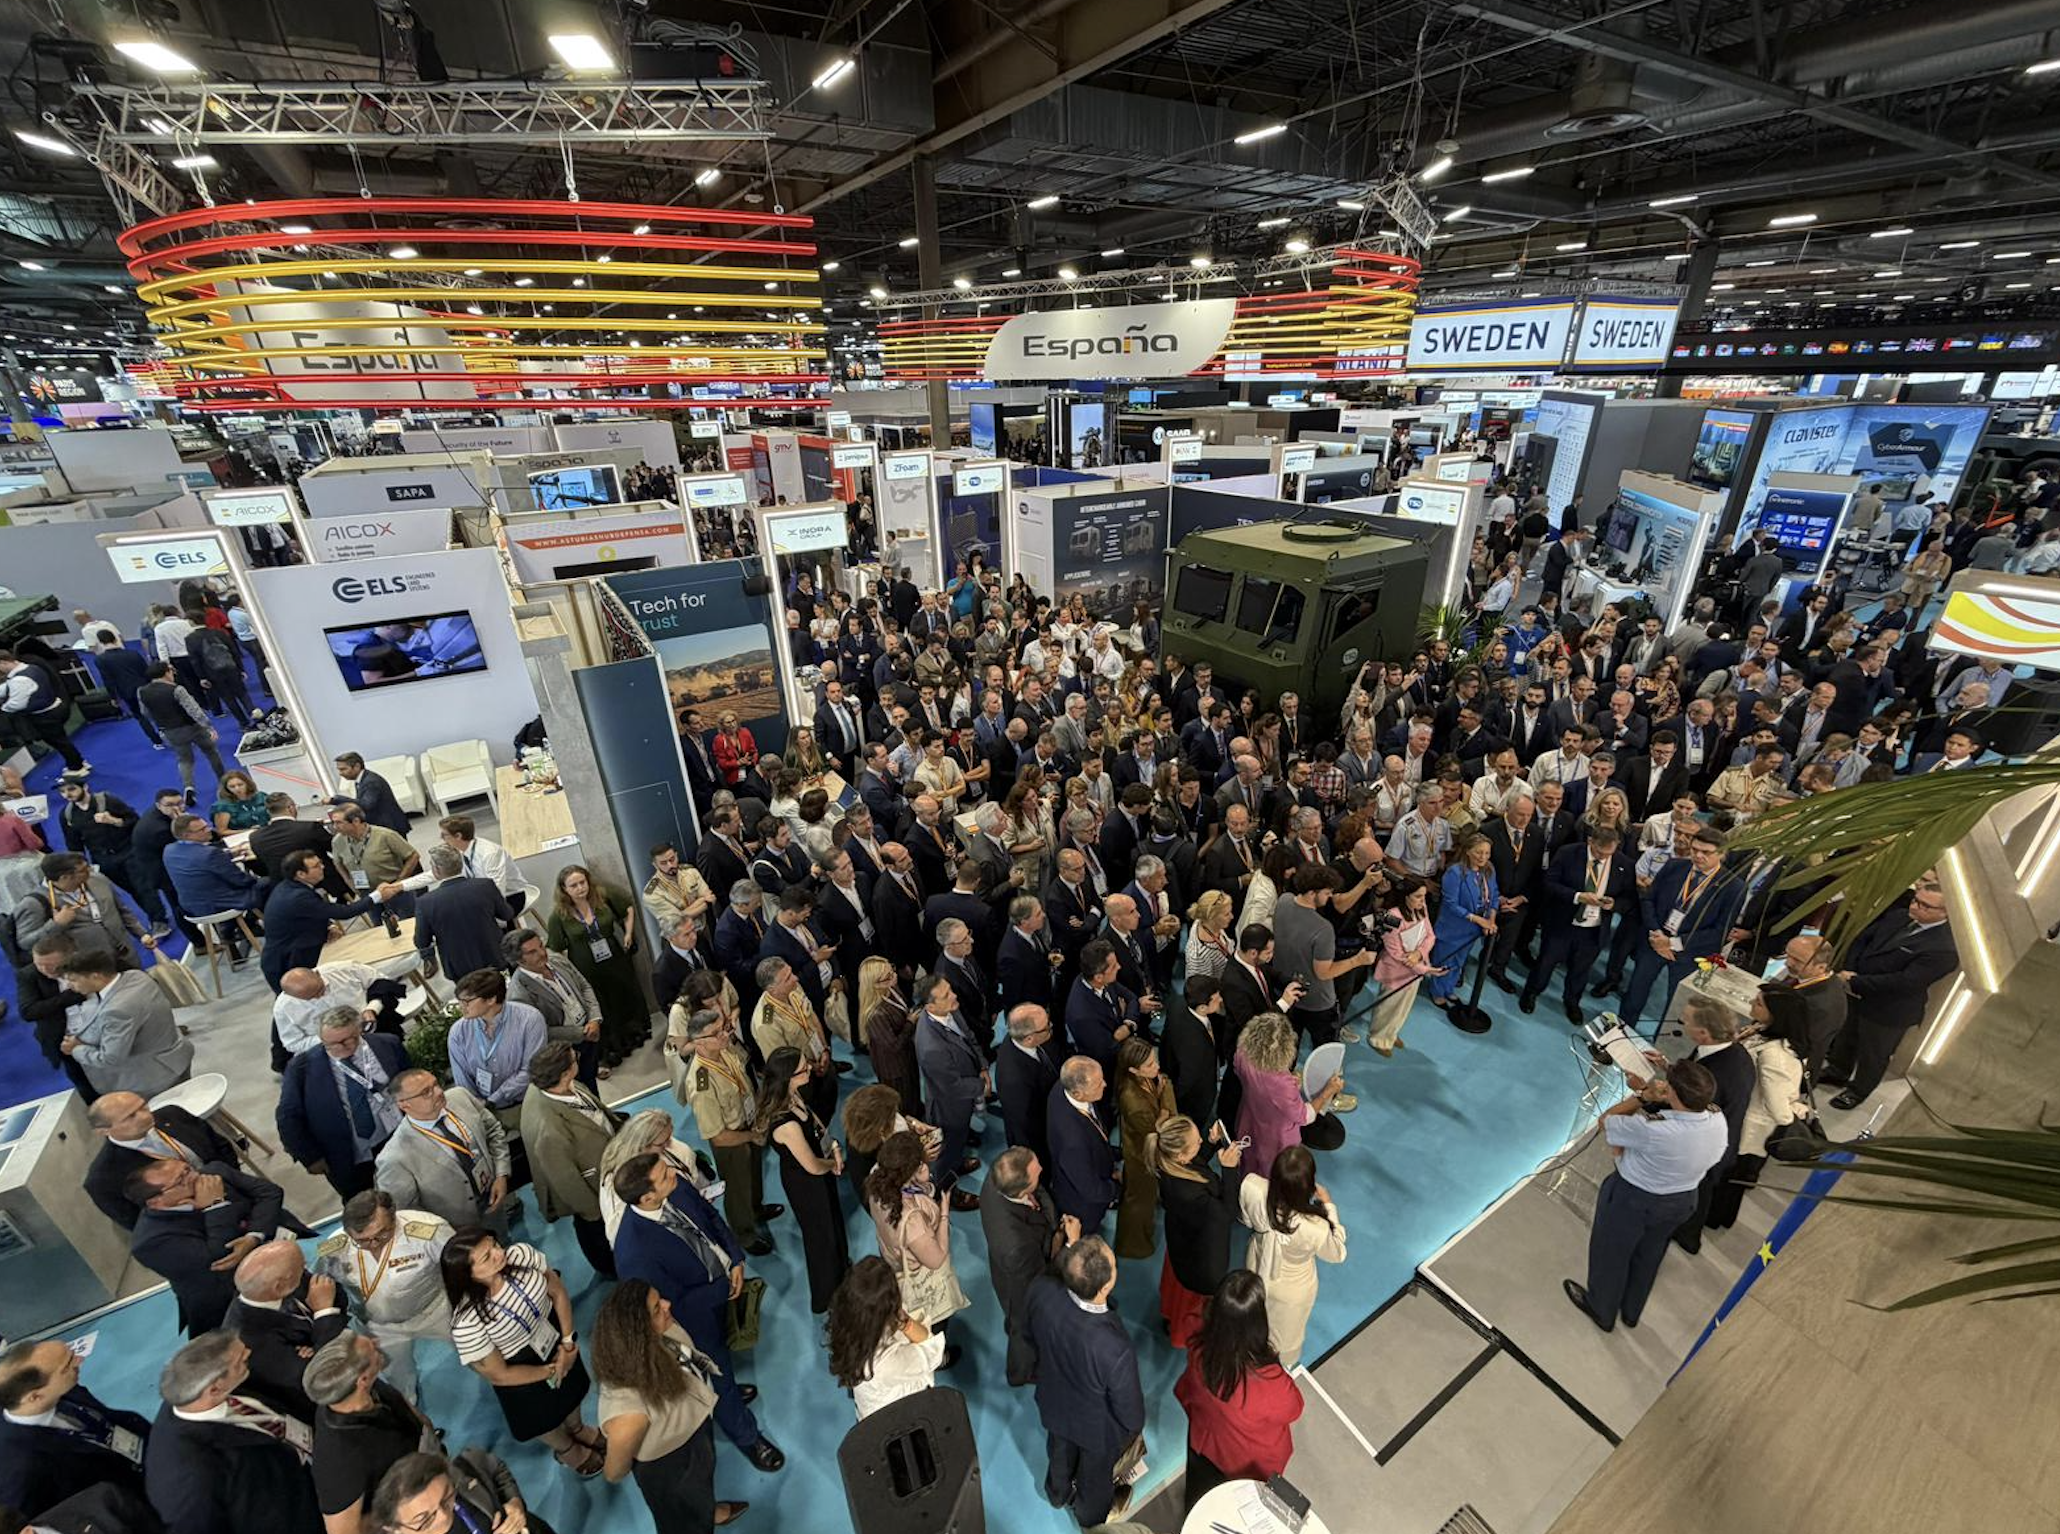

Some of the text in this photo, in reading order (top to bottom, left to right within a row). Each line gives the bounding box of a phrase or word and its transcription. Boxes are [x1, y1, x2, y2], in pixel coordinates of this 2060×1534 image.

[1023, 323, 1178, 361] España
[1423, 320, 1550, 355] SWEDEN
[1589, 319, 1666, 349] SWEDEN
[894, 463, 920, 473] ZFoam
[395, 486, 428, 498] SAPA
[235, 505, 277, 516] AICOX
[325, 522, 396, 541] AICOX
[179, 552, 207, 565] ELS
[366, 576, 407, 596] ELS
[629, 592, 707, 617] Tech for
